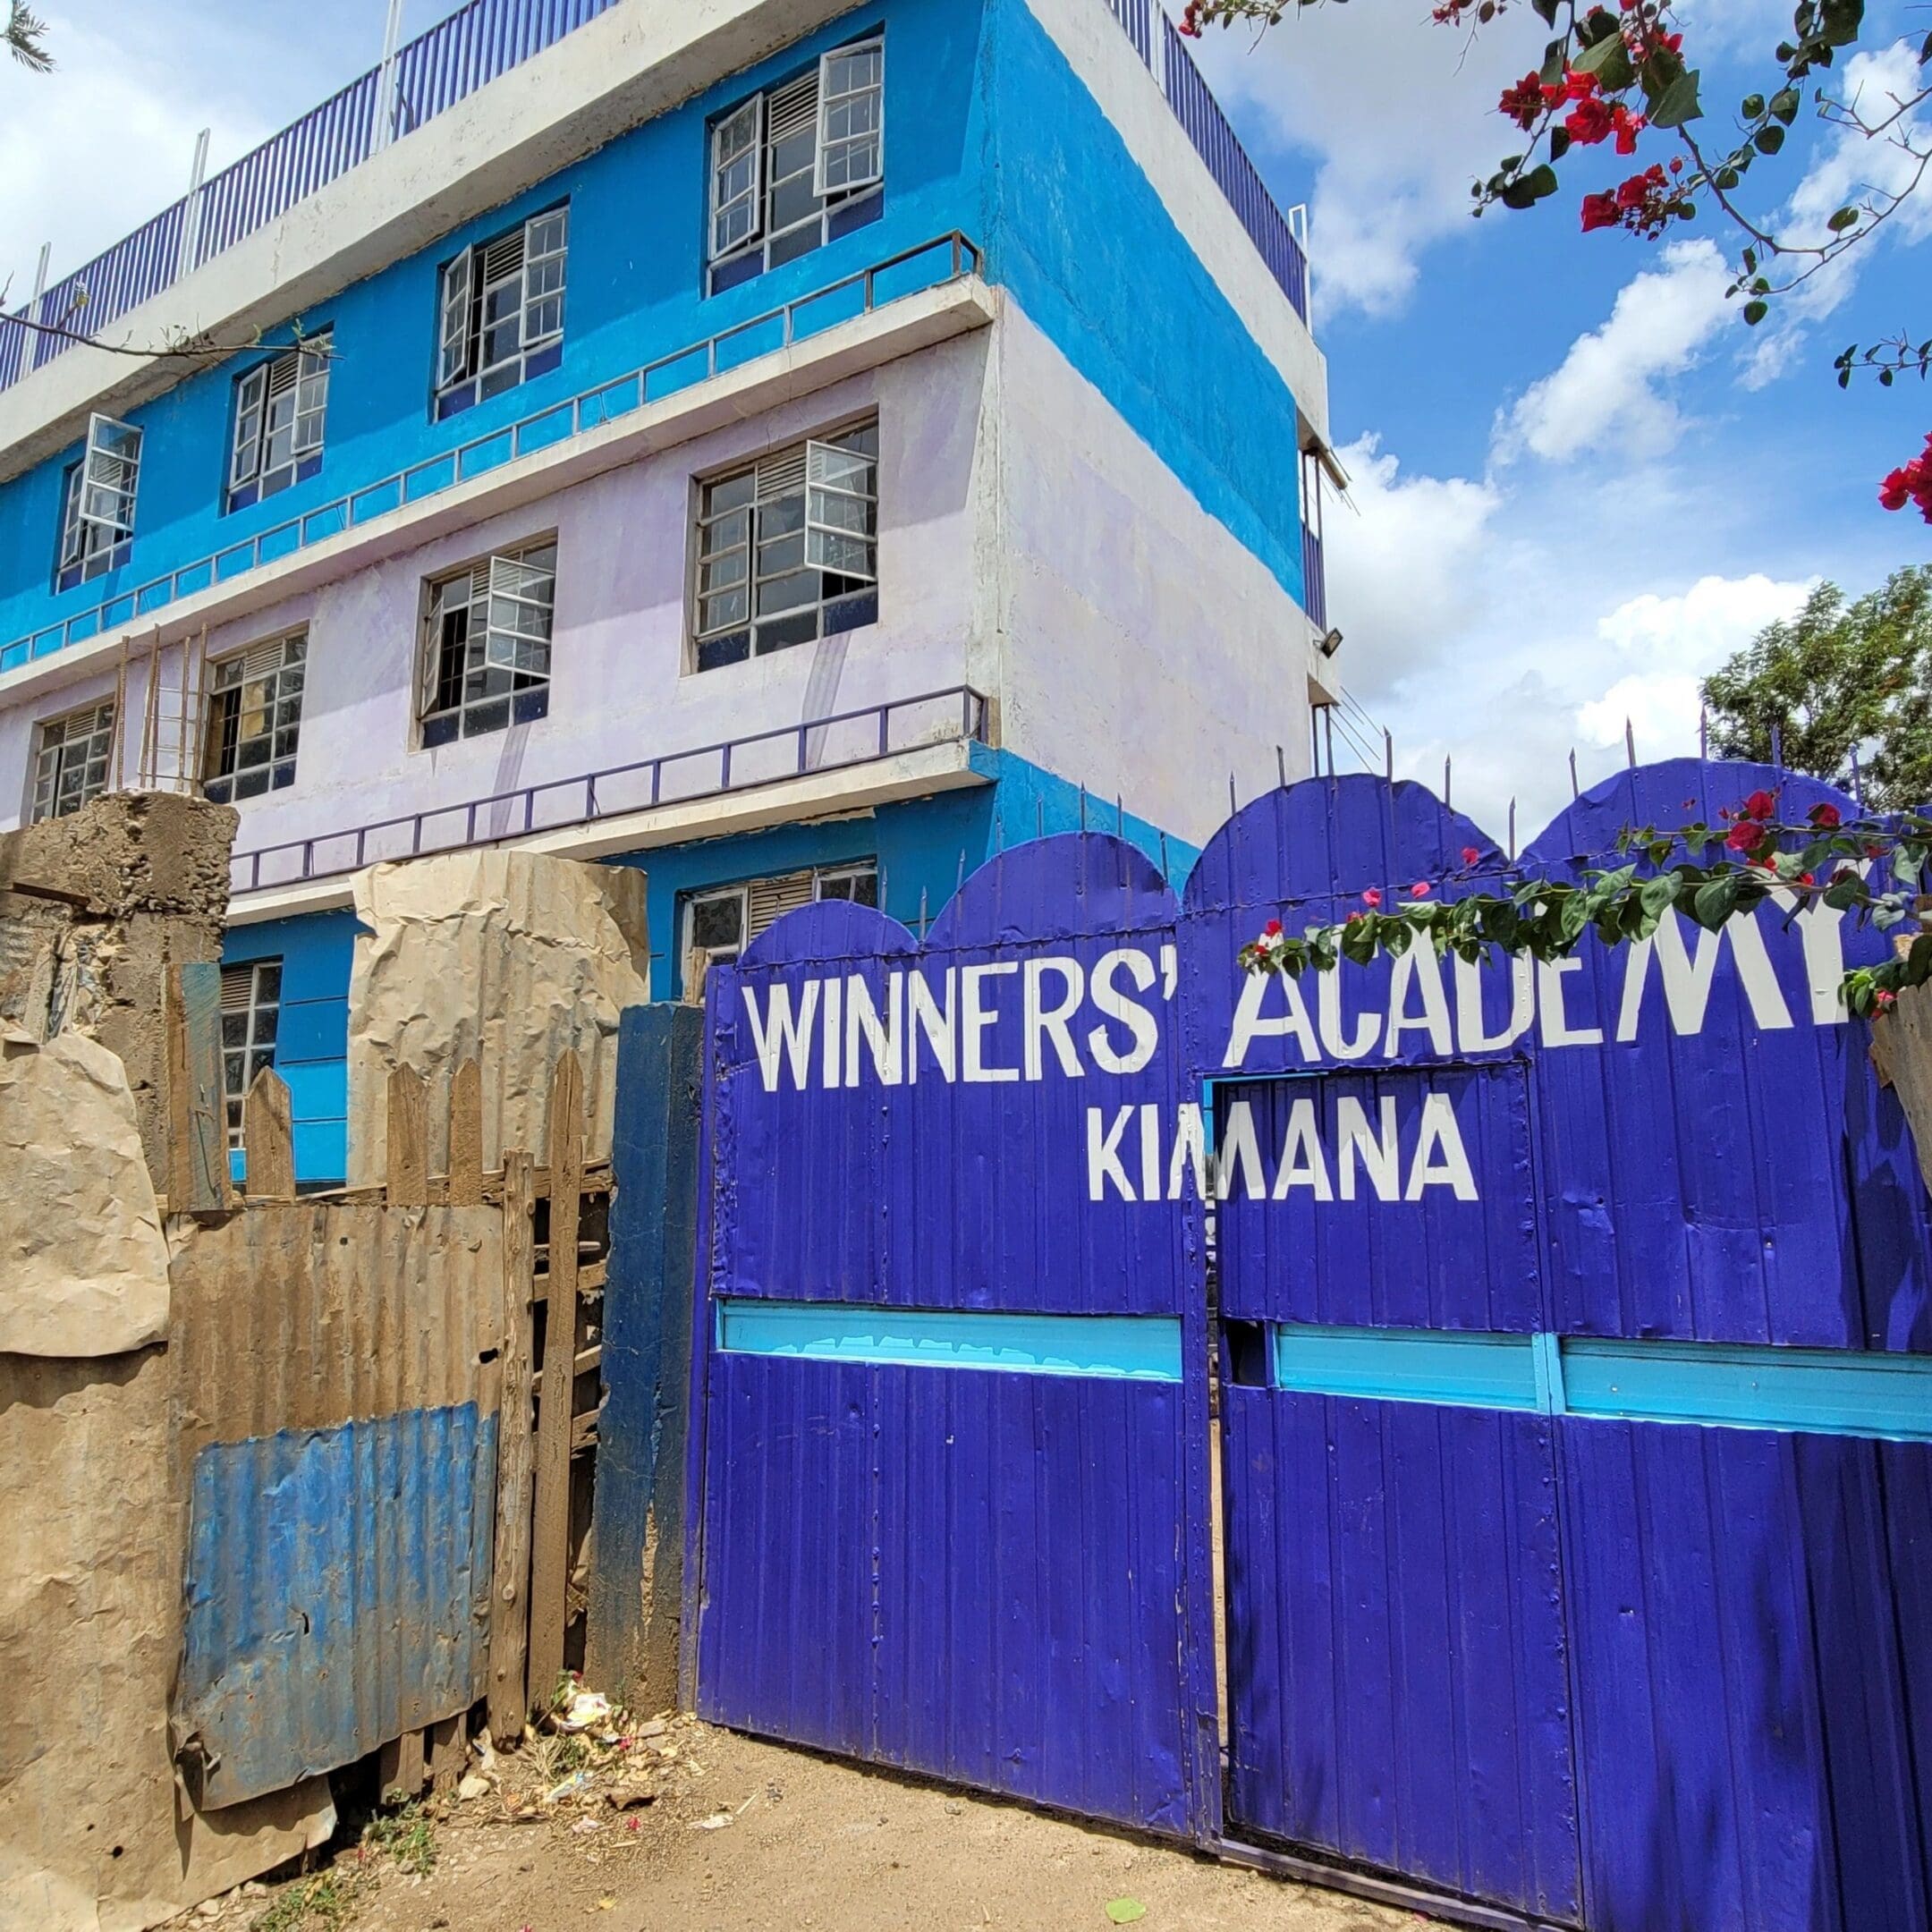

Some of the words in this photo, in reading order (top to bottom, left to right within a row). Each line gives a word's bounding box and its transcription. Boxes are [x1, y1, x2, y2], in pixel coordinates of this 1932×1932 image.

[741, 944, 1177, 1092] WINNERS'
[1223, 858, 1873, 1067] ACADEMY
[1087, 1092, 1479, 1201] KIMANA
